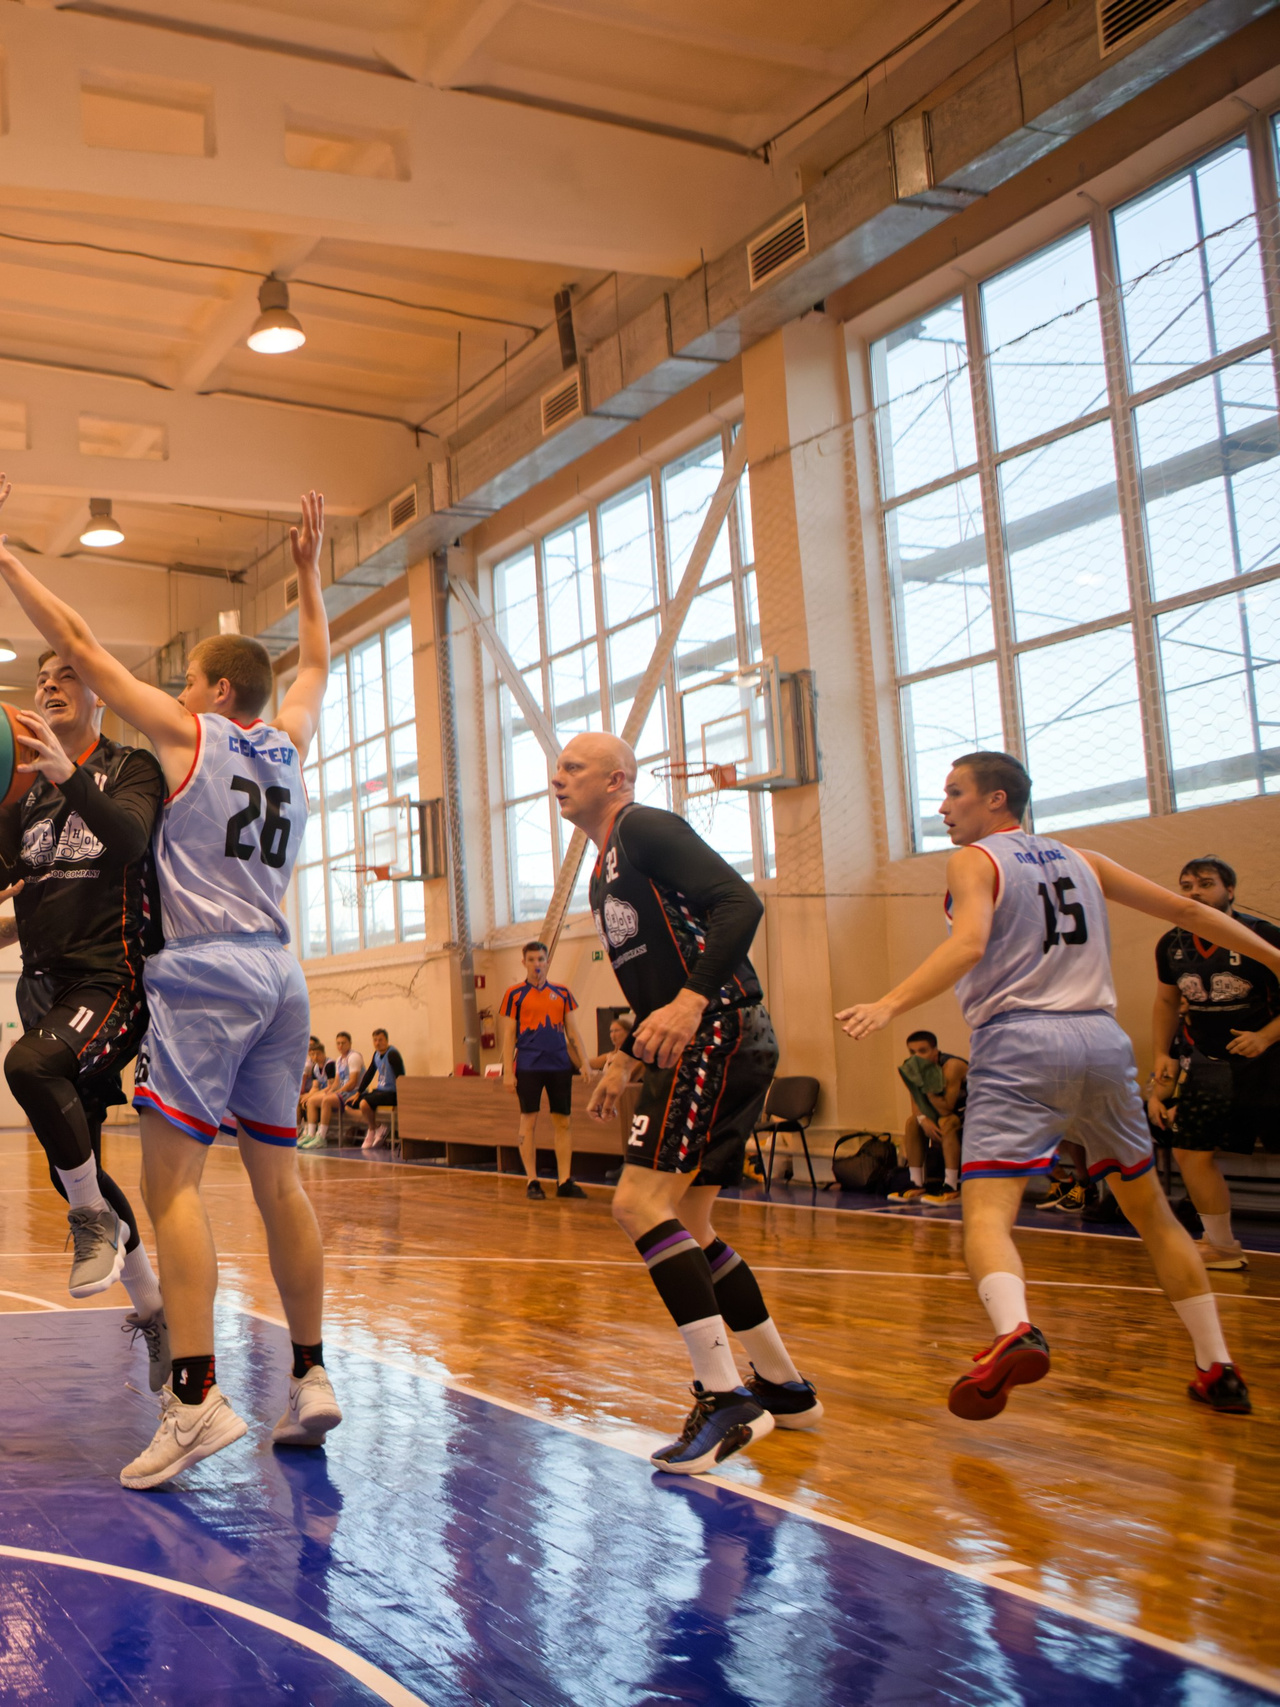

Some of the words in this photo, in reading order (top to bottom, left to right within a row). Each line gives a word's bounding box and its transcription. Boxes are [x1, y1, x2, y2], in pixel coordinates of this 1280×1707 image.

[224, 774, 292, 869] 26
[605, 846, 620, 884] 32
[1038, 876, 1088, 955] 15
[68, 1005, 95, 1033] 11
